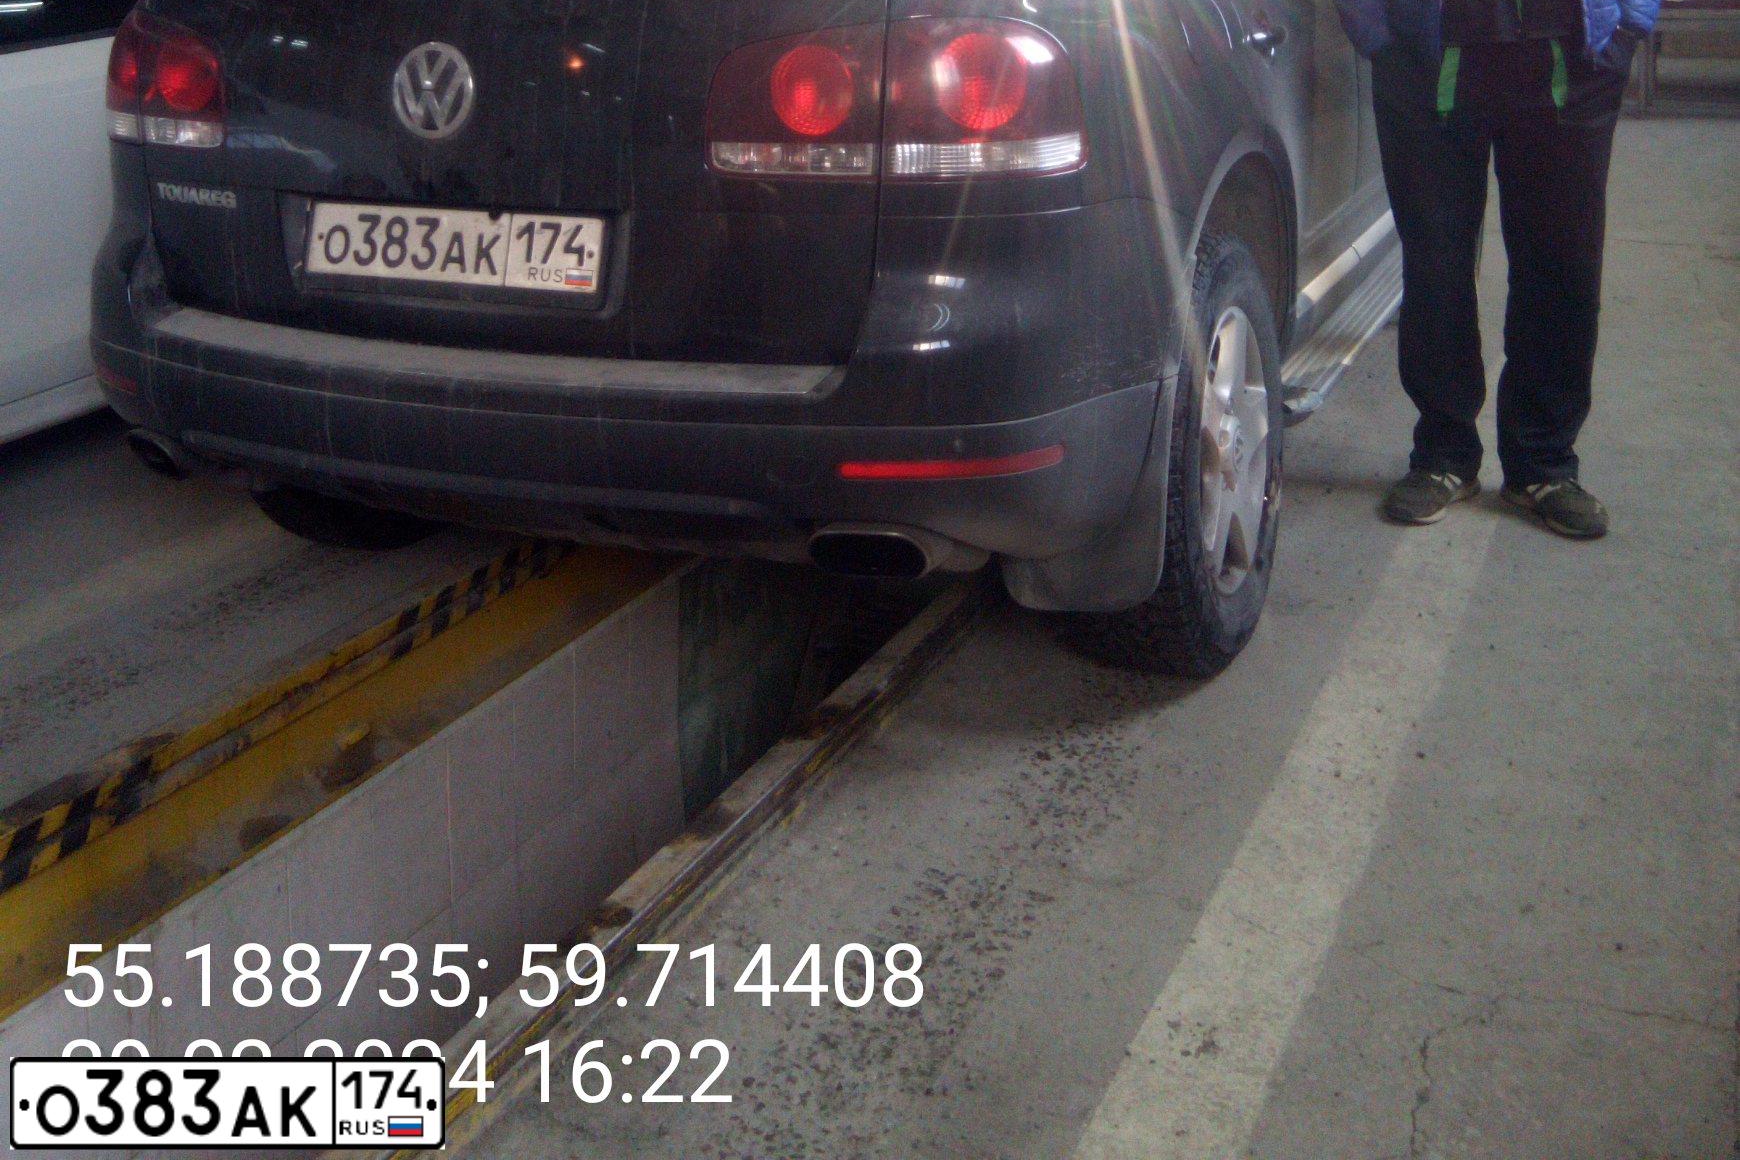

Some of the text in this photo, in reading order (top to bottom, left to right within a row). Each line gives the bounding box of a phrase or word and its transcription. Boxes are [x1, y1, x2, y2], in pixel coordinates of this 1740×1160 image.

[157, 182, 237, 209] TOUAREG
[516, 221, 586, 267] 174
[528, 267, 563, 282] RUS
